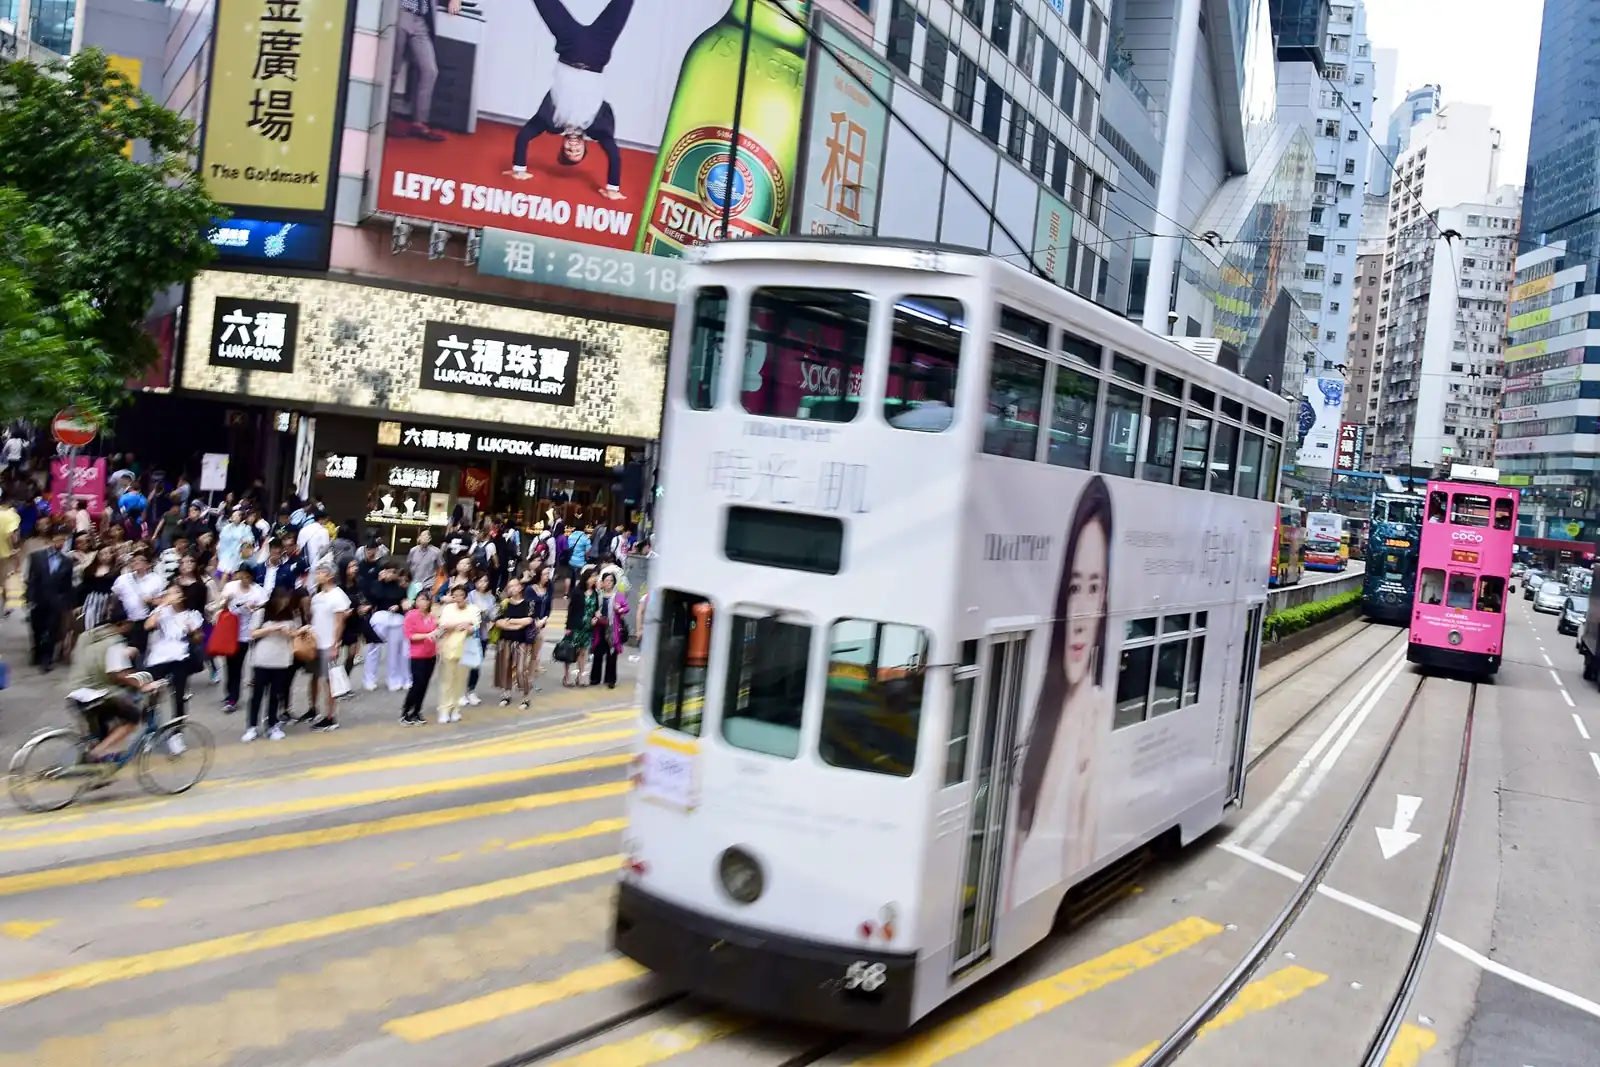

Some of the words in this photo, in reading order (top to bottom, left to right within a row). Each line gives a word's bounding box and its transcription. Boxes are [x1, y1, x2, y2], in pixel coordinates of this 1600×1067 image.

[211, 164, 239, 179] The
[244, 166, 319, 184] Goldmark
[821, 111, 867, 222] 租
[393, 171, 455, 205] LET'S
[461, 183, 570, 225] TSINGTAO
[575, 204, 633, 236] NOW
[566, 253, 636, 287] 2523
[220, 309, 287, 348] 六福
[218, 344, 282, 362] LUKFOOK
[434, 335, 570, 382] 六福珠寶
[434, 368, 493, 387] LUKFOOK
[494, 376, 566, 395] JEWELLERY
[404, 427, 471, 451] 六福珠寶
[477, 437, 534, 456] LUKFOOK
[535, 443, 603, 462] JEWELLERY
[1452, 532, 1483, 543] COCO
